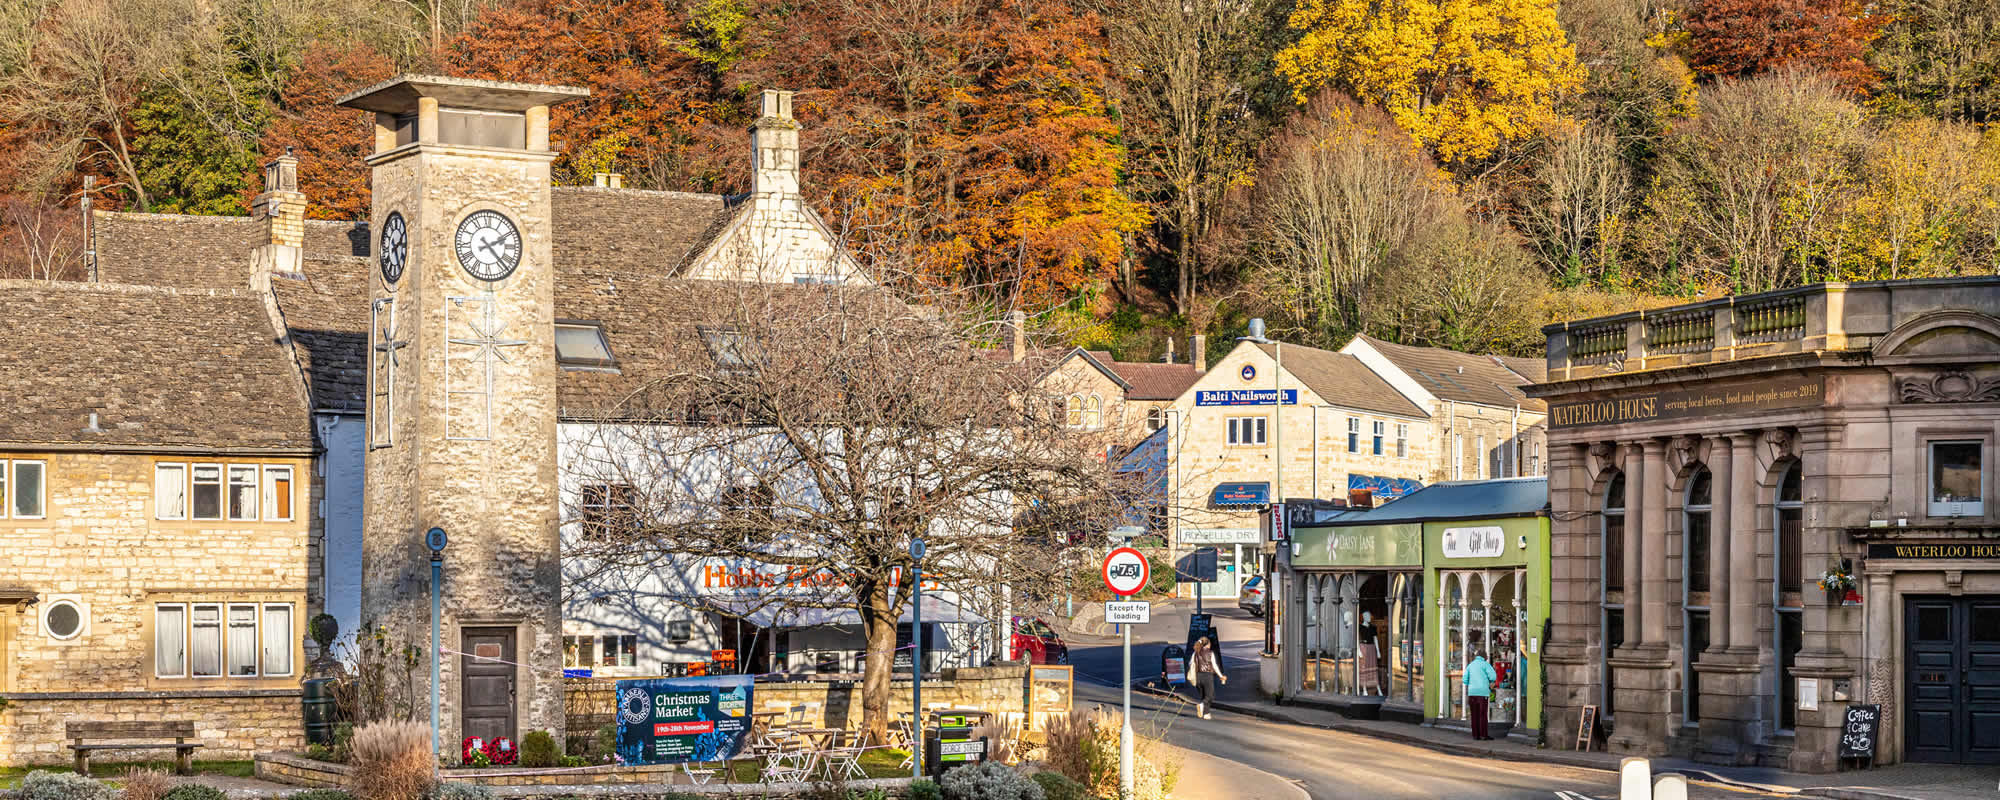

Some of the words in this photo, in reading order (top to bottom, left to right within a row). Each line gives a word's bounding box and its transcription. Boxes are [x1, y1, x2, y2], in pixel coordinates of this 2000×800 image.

[1202, 391, 1228, 401] Balti
[1231, 390, 1289, 401] Nailsworh
[1552, 400, 1615, 426] WATERLOO
[1618, 397, 1658, 420] HOUSE
[1664, 400, 1688, 410] serving
[1688, 397, 1703, 408] local
[1705, 396, 1724, 406] beers,
[1726, 392, 1740, 404] food
[1741, 391, 1755, 403] and
[1755, 389, 1777, 404] people
[1779, 387, 1798, 399] since
[1799, 384, 1818, 397] 2019
[1236, 531, 1257, 540] DRY
[1469, 531, 1482, 554] Gift
[1484, 531, 1500, 553] Shop
[1895, 545, 1967, 557] WATERLOO
[1119, 565, 1138, 576] 7.5T
[704, 565, 775, 588] Hobbs
[1108, 604, 1134, 612] Except
[1114, 612, 1140, 620] loading
[1471, 608, 1483, 621] TOYS
[655, 693, 710, 706] Christmas
[655, 705, 694, 718] Market
[1847, 709, 1874, 721] Coffee
[683, 723, 710, 732] November
[1851, 722, 1871, 732] Cake
[963, 742, 983, 752] STREET
